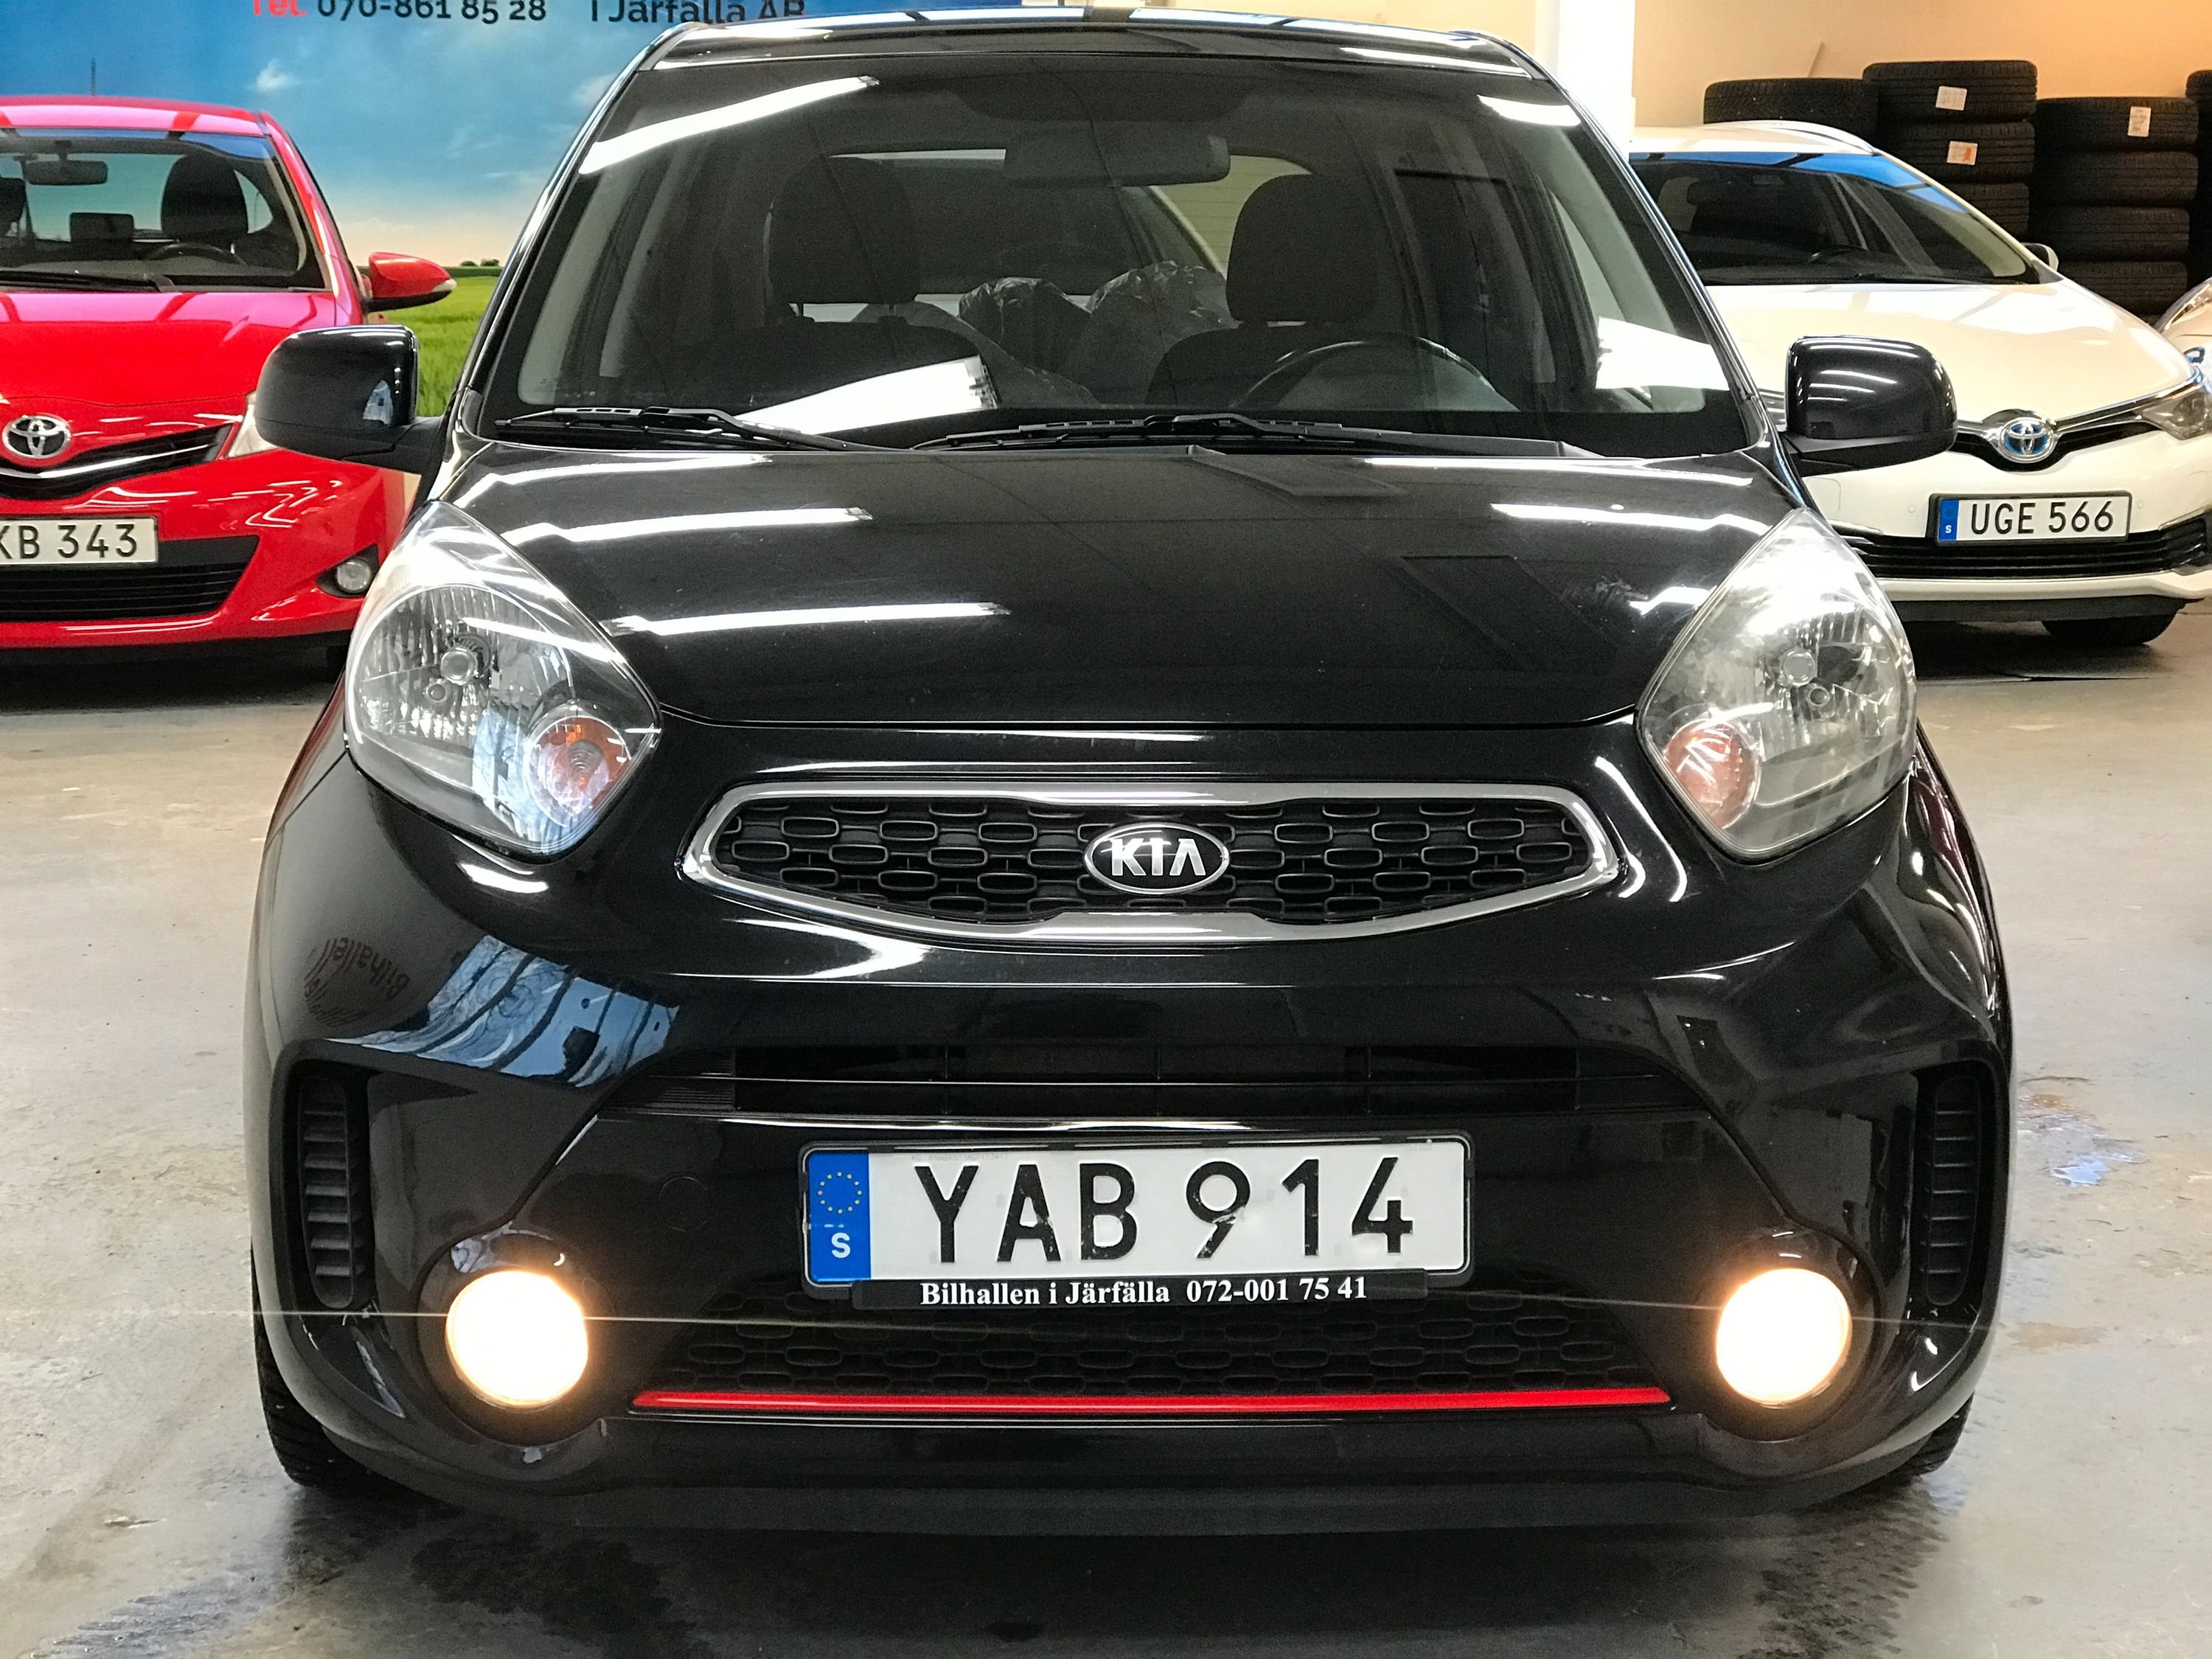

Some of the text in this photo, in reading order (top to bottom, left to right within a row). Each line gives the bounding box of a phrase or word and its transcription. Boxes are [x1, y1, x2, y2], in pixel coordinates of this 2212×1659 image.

[462, 0, 498, 24] 85
[509, 0, 546, 21] 28
[1945, 524, 1952, 534] S
[1971, 501, 2114, 535] UGE 566
[58, 524, 137, 558] 343
[1110, 838, 1206, 876] KIA
[914, 1157, 1413, 1263] YAB 914
[831, 1232, 851, 1259] S
[920, 1276, 1367, 1304] Bilhallen i Järfälla 072-001 75 41
